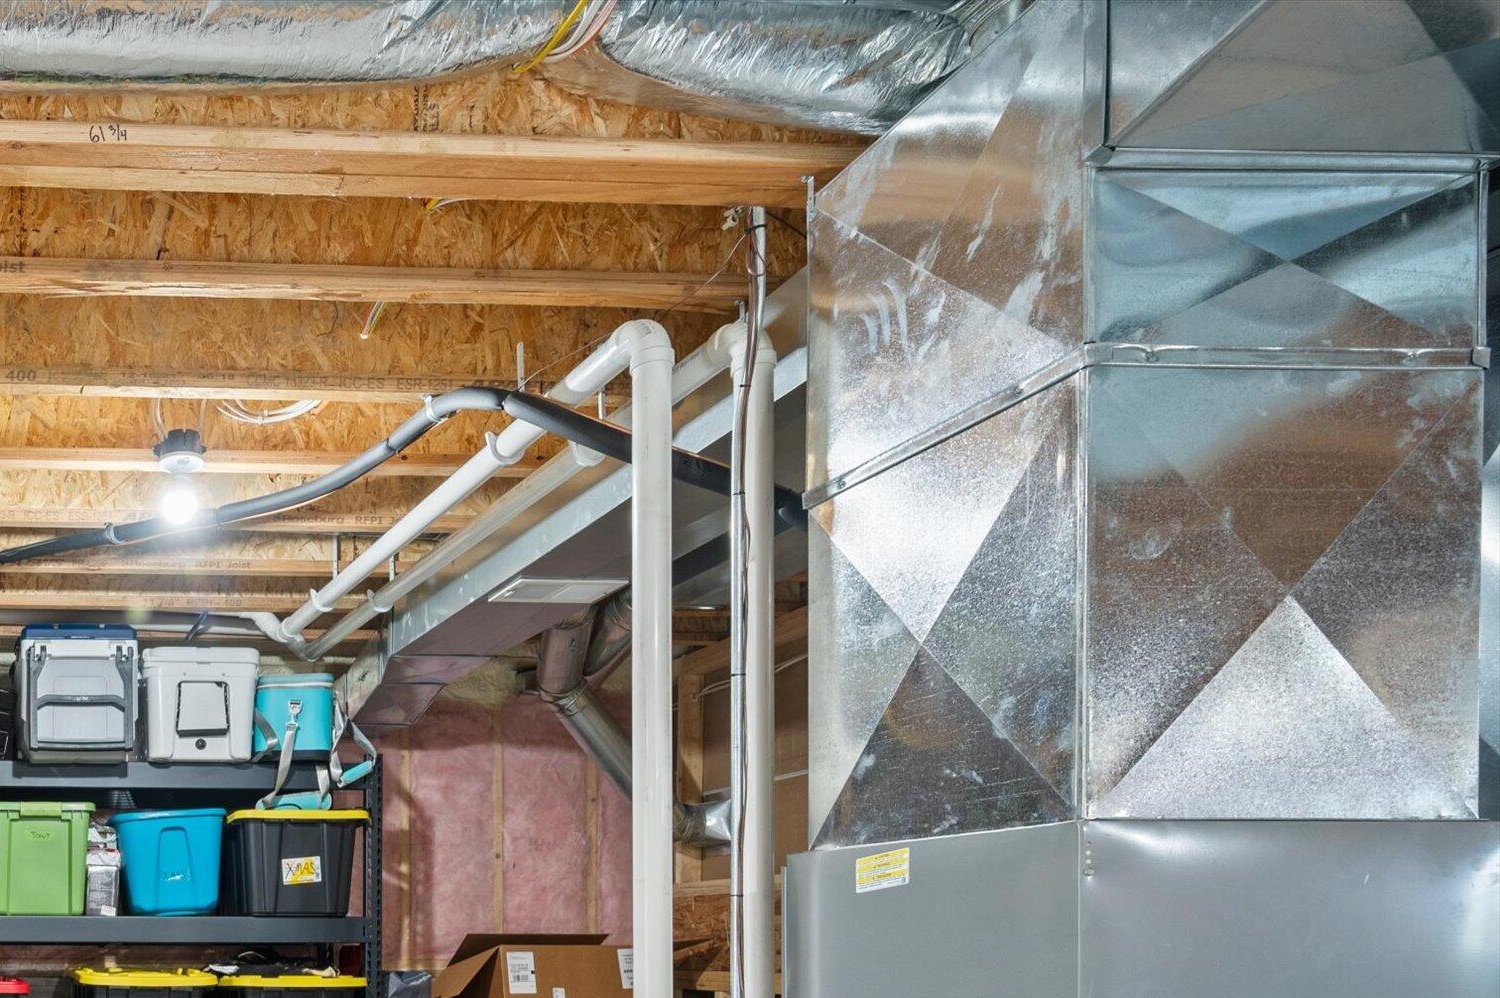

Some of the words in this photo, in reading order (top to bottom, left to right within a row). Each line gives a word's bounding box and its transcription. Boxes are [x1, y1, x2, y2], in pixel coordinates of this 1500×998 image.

[89, 125, 106, 143] 61
[108, 123, 127, 141] 3/4
[6, 369, 37, 382] 400
[337, 376, 386, 389] ICC-ES
[355, 515, 384, 525] RFPI
